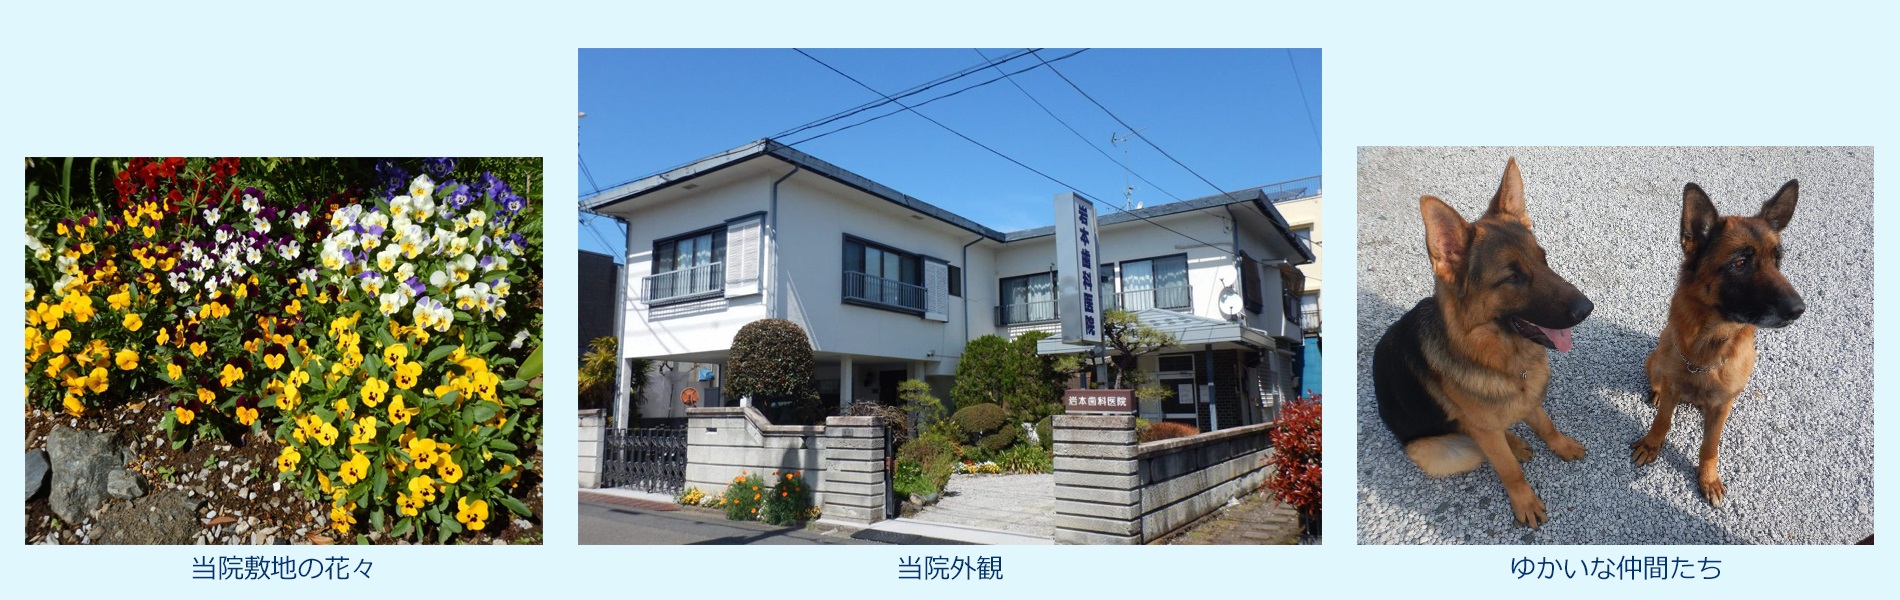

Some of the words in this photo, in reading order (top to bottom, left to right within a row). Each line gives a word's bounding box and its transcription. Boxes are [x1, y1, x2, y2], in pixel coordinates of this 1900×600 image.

[1078, 204, 1096, 336] 岩本歯科医院
[1068, 396, 1127, 407] 岩本歯科医院
